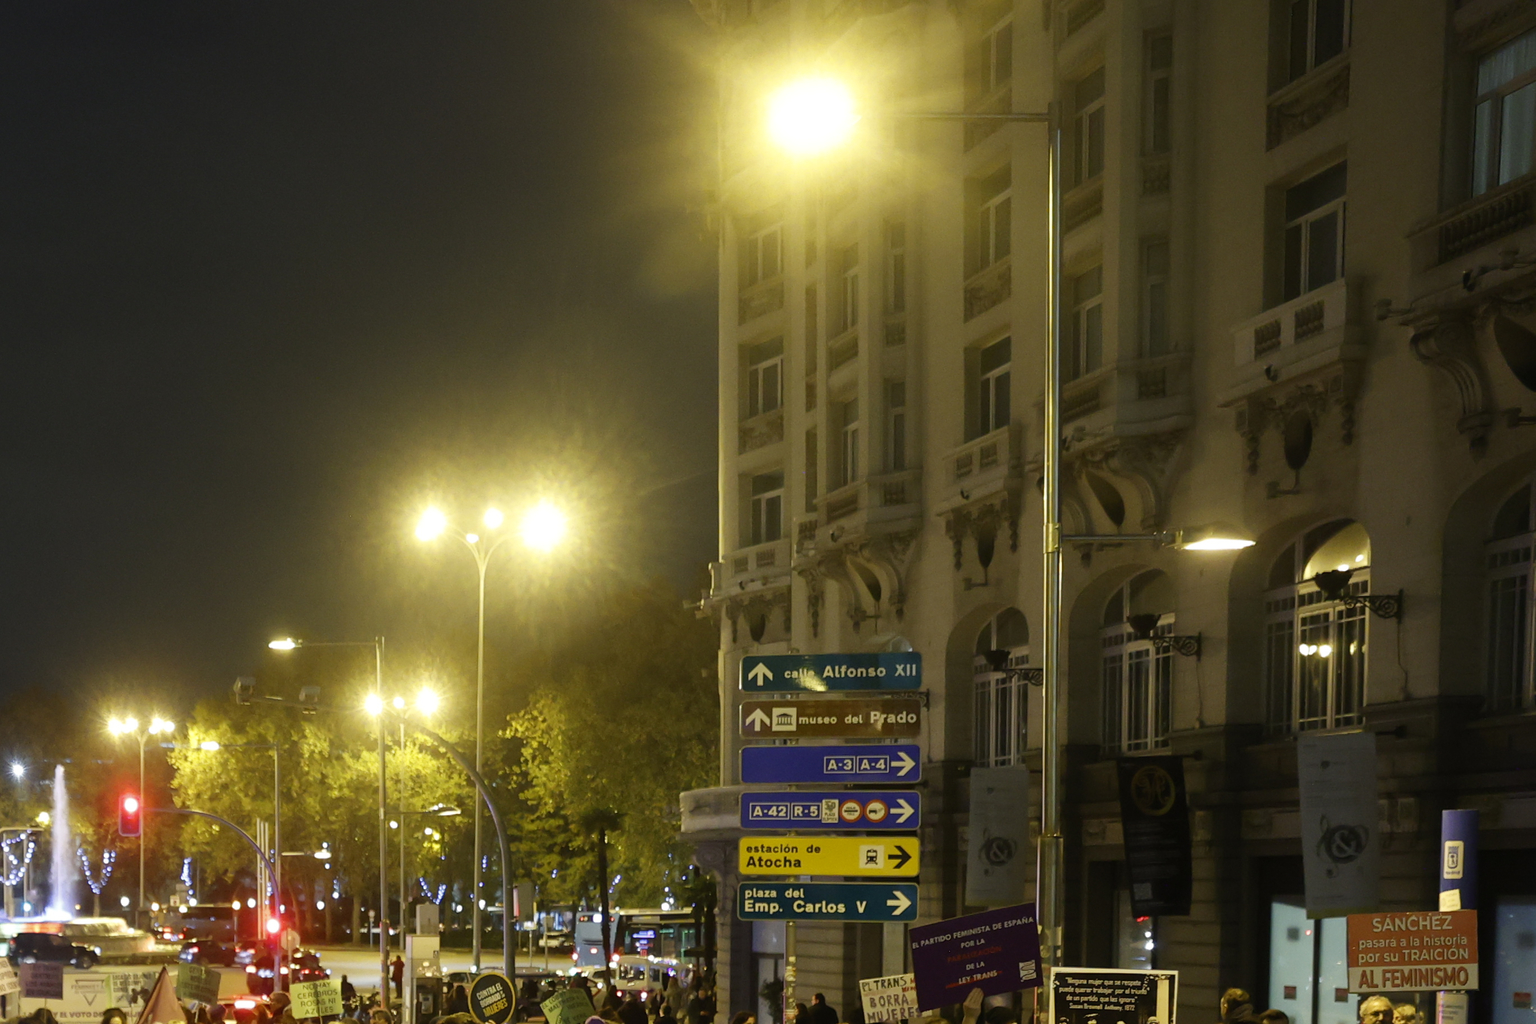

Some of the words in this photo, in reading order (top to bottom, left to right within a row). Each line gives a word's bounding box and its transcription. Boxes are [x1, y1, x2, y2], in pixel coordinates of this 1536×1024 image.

[784, 668, 815, 679] calle
[823, 665, 886, 678] Alfonso
[894, 664, 917, 677] XII
[798, 715, 838, 725] museo
[845, 714, 863, 724] del
[870, 711, 917, 724] Prado
[828, 759, 853, 771] A-3
[860, 759, 886, 770] A-4
[753, 806, 787, 817] A-42
[794, 806, 819, 816] R-5
[746, 844, 799, 854] estación
[806, 844, 821, 854] de
[746, 856, 802, 868] Atocha
[744, 888, 777, 900] plaza
[785, 888, 804, 898] del
[744, 901, 784, 914] Emp.
[793, 900, 846, 913] Carlos
[856, 901, 867, 913] V
[1372, 914, 1453, 932] SÁNCHEZ
[921, 934, 952, 947] PARTIDO
[953, 926, 991, 939] FEMINISTA
[992, 922, 1003, 930] DE
[1004, 916, 1034, 928] ESPAÑA
[960, 941, 975, 949] POR
[976, 938, 986, 946] LA
[1359, 937, 1396, 950] pasará
[1400, 939, 1406, 947] a
[1410, 936, 1420, 946] la
[1424, 934, 1467, 946] historia
[1359, 953, 1380, 965] por
[1384, 953, 1399, 962] su
[1402, 946, 1469, 961] TRAICIÓN
[965, 963, 975, 971] DE
[976, 961, 985, 969] LA
[874, 977, 907, 990] TRANS
[958, 976, 972, 984] LEY
[973, 970, 998, 981] TRANS
[1359, 970, 1378, 989] AL
[1382, 966, 1469, 988] FEMINISMO
[869, 994, 909, 1009] BORRA
[304, 1007, 334, 1015] AZLES
[867, 1006, 922, 1024] MUJERES
